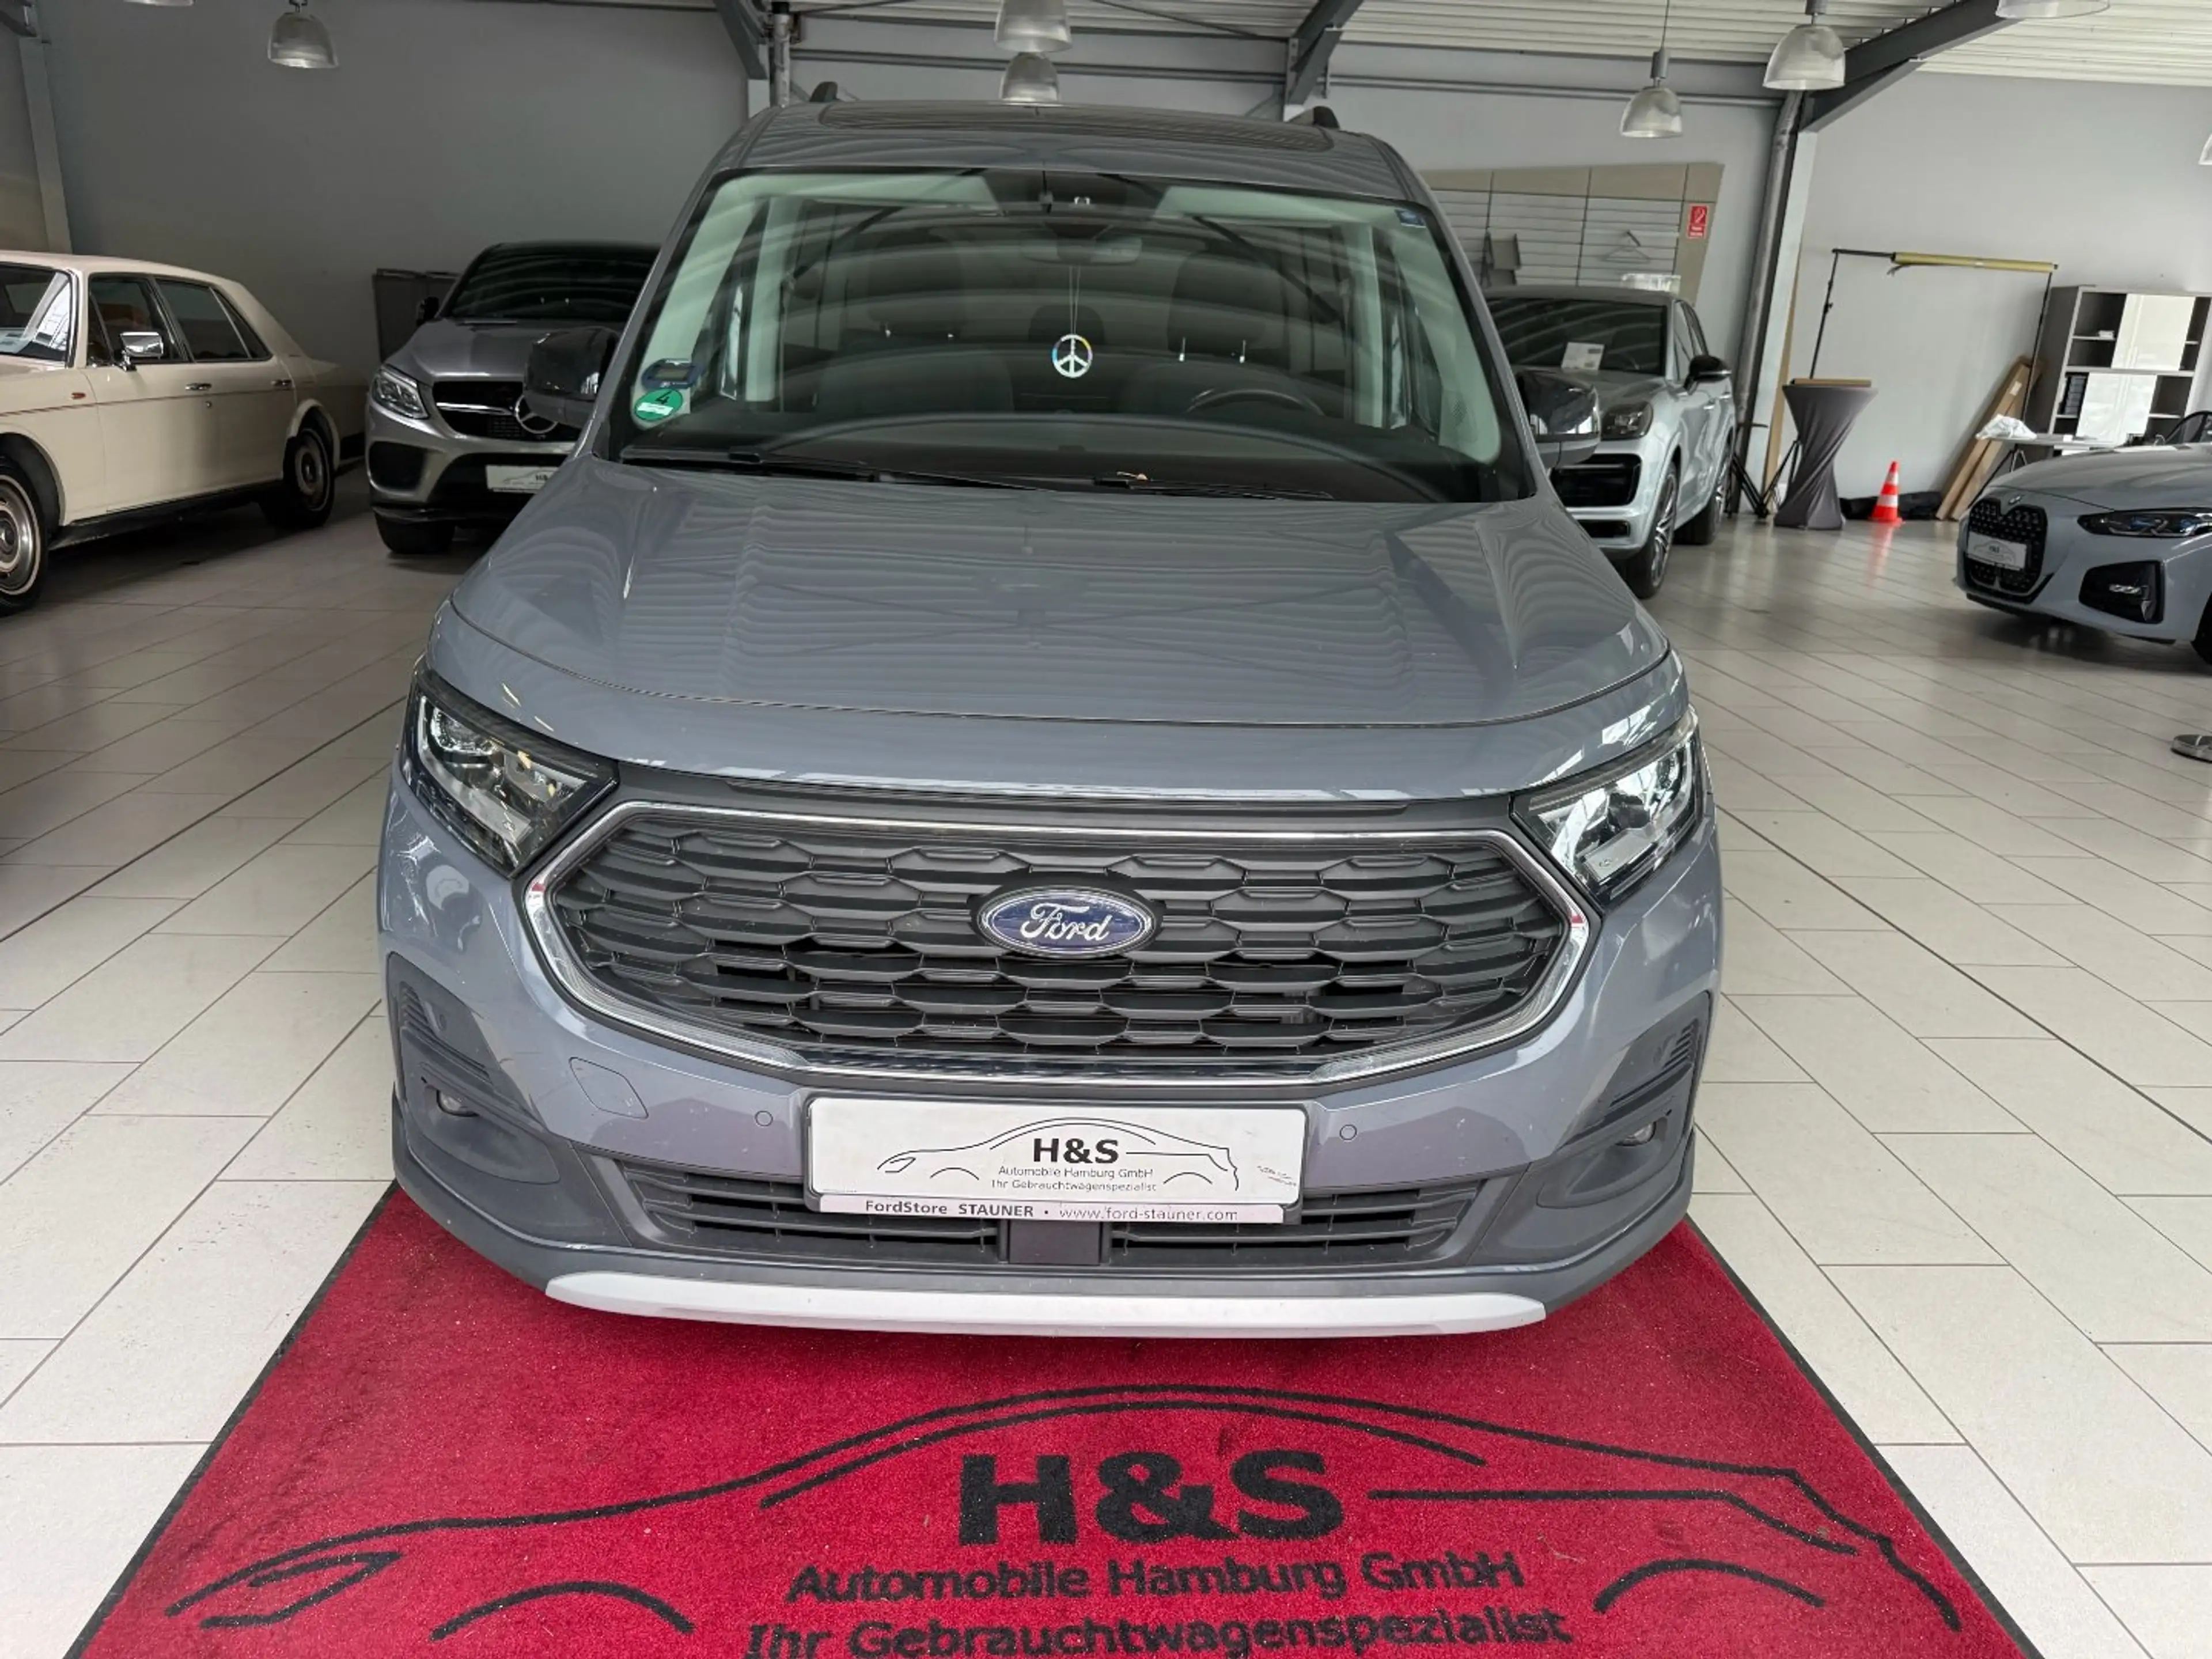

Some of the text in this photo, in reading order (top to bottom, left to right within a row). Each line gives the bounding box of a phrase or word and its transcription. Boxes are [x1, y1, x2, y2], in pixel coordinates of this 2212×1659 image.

[655, 390, 672, 404] 4
[1020, 903, 1113, 941] Ford
[1033, 1138, 1119, 1164] H&S
[991, 1179, 1157, 1192] Ihr Gebrauchtwagenspezialist
[998, 1166, 1153, 1180] Automobile Hamburg GmbH
[866, 1200, 1238, 1221] FordStore STAUNER www.ford-stauner.com
[959, 1449, 1344, 1545] H&S
[786, 1551, 1525, 1603] Automobile Hamburg GmbH
[744, 1606, 1573, 1659] Ihr Gebrauchtwagenspezialist
